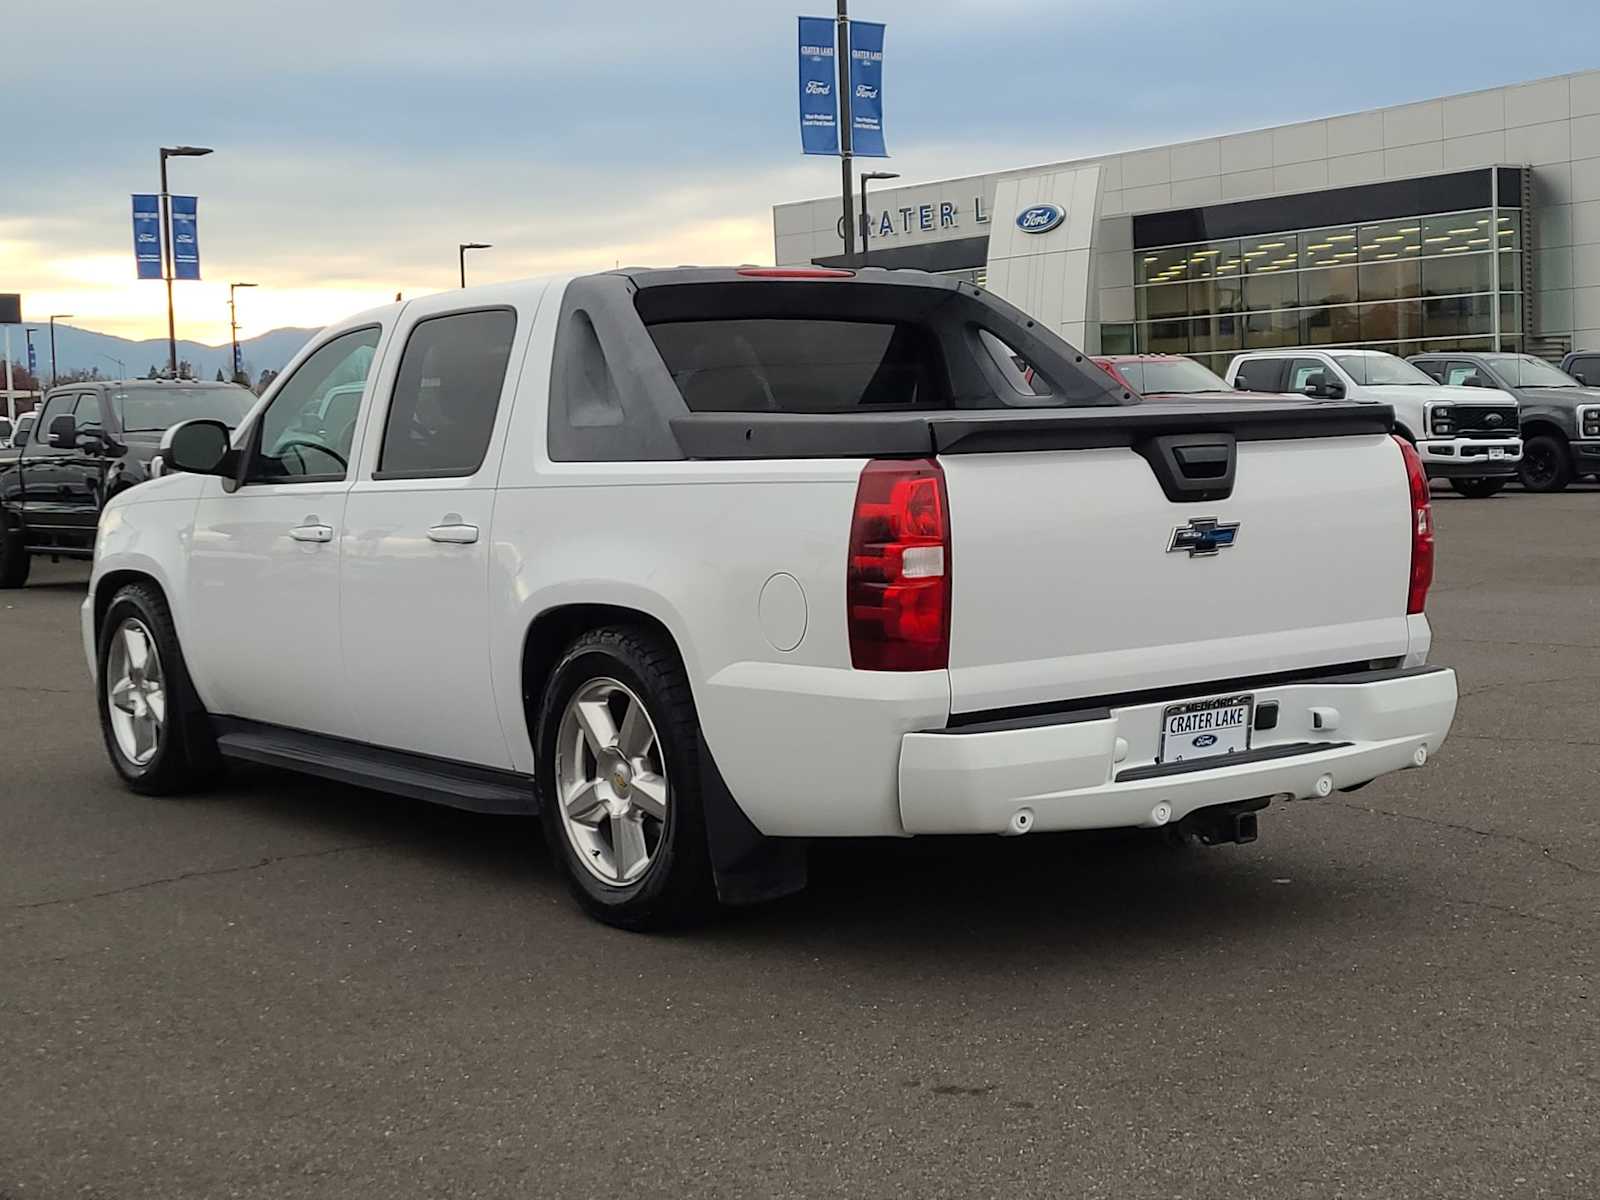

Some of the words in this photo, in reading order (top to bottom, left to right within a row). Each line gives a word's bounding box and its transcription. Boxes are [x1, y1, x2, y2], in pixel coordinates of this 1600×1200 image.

[805, 80, 831, 95] Ford
[855, 84, 878, 98] Ford
[1023, 208, 1051, 227] Ford
[1170, 711, 1212, 734] CRATER
[1215, 708, 1244, 727] LAKE
